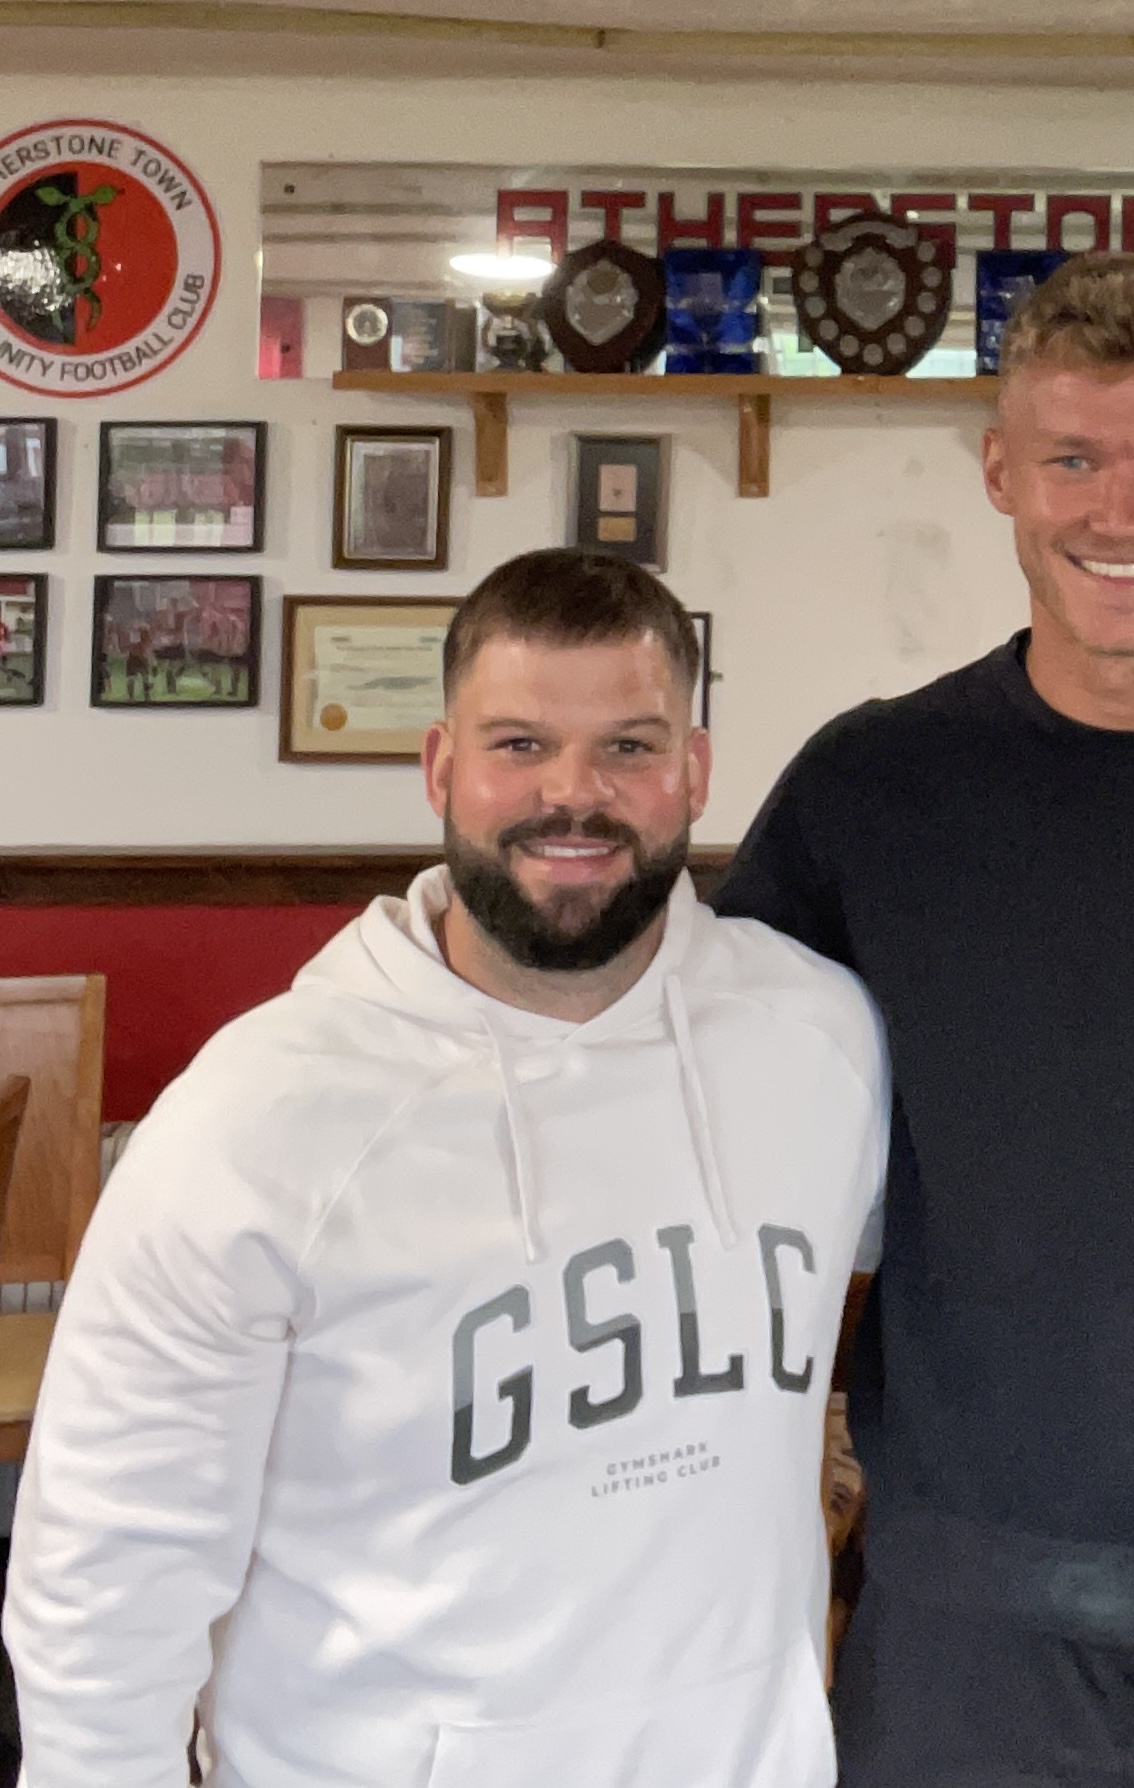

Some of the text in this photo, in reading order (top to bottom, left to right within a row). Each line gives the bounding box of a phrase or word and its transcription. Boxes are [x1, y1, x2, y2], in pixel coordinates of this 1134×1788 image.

[0, 135, 193, 211] ERSTONE TOWN
[60, 332, 175, 382] FOOTBALL
[167, 273, 206, 330] CLUB
[451, 1223, 816, 1487] GSLC
[591, 1455, 721, 1497] LIFTING CLUB
[606, 1441, 708, 1476] GYMSHARK
